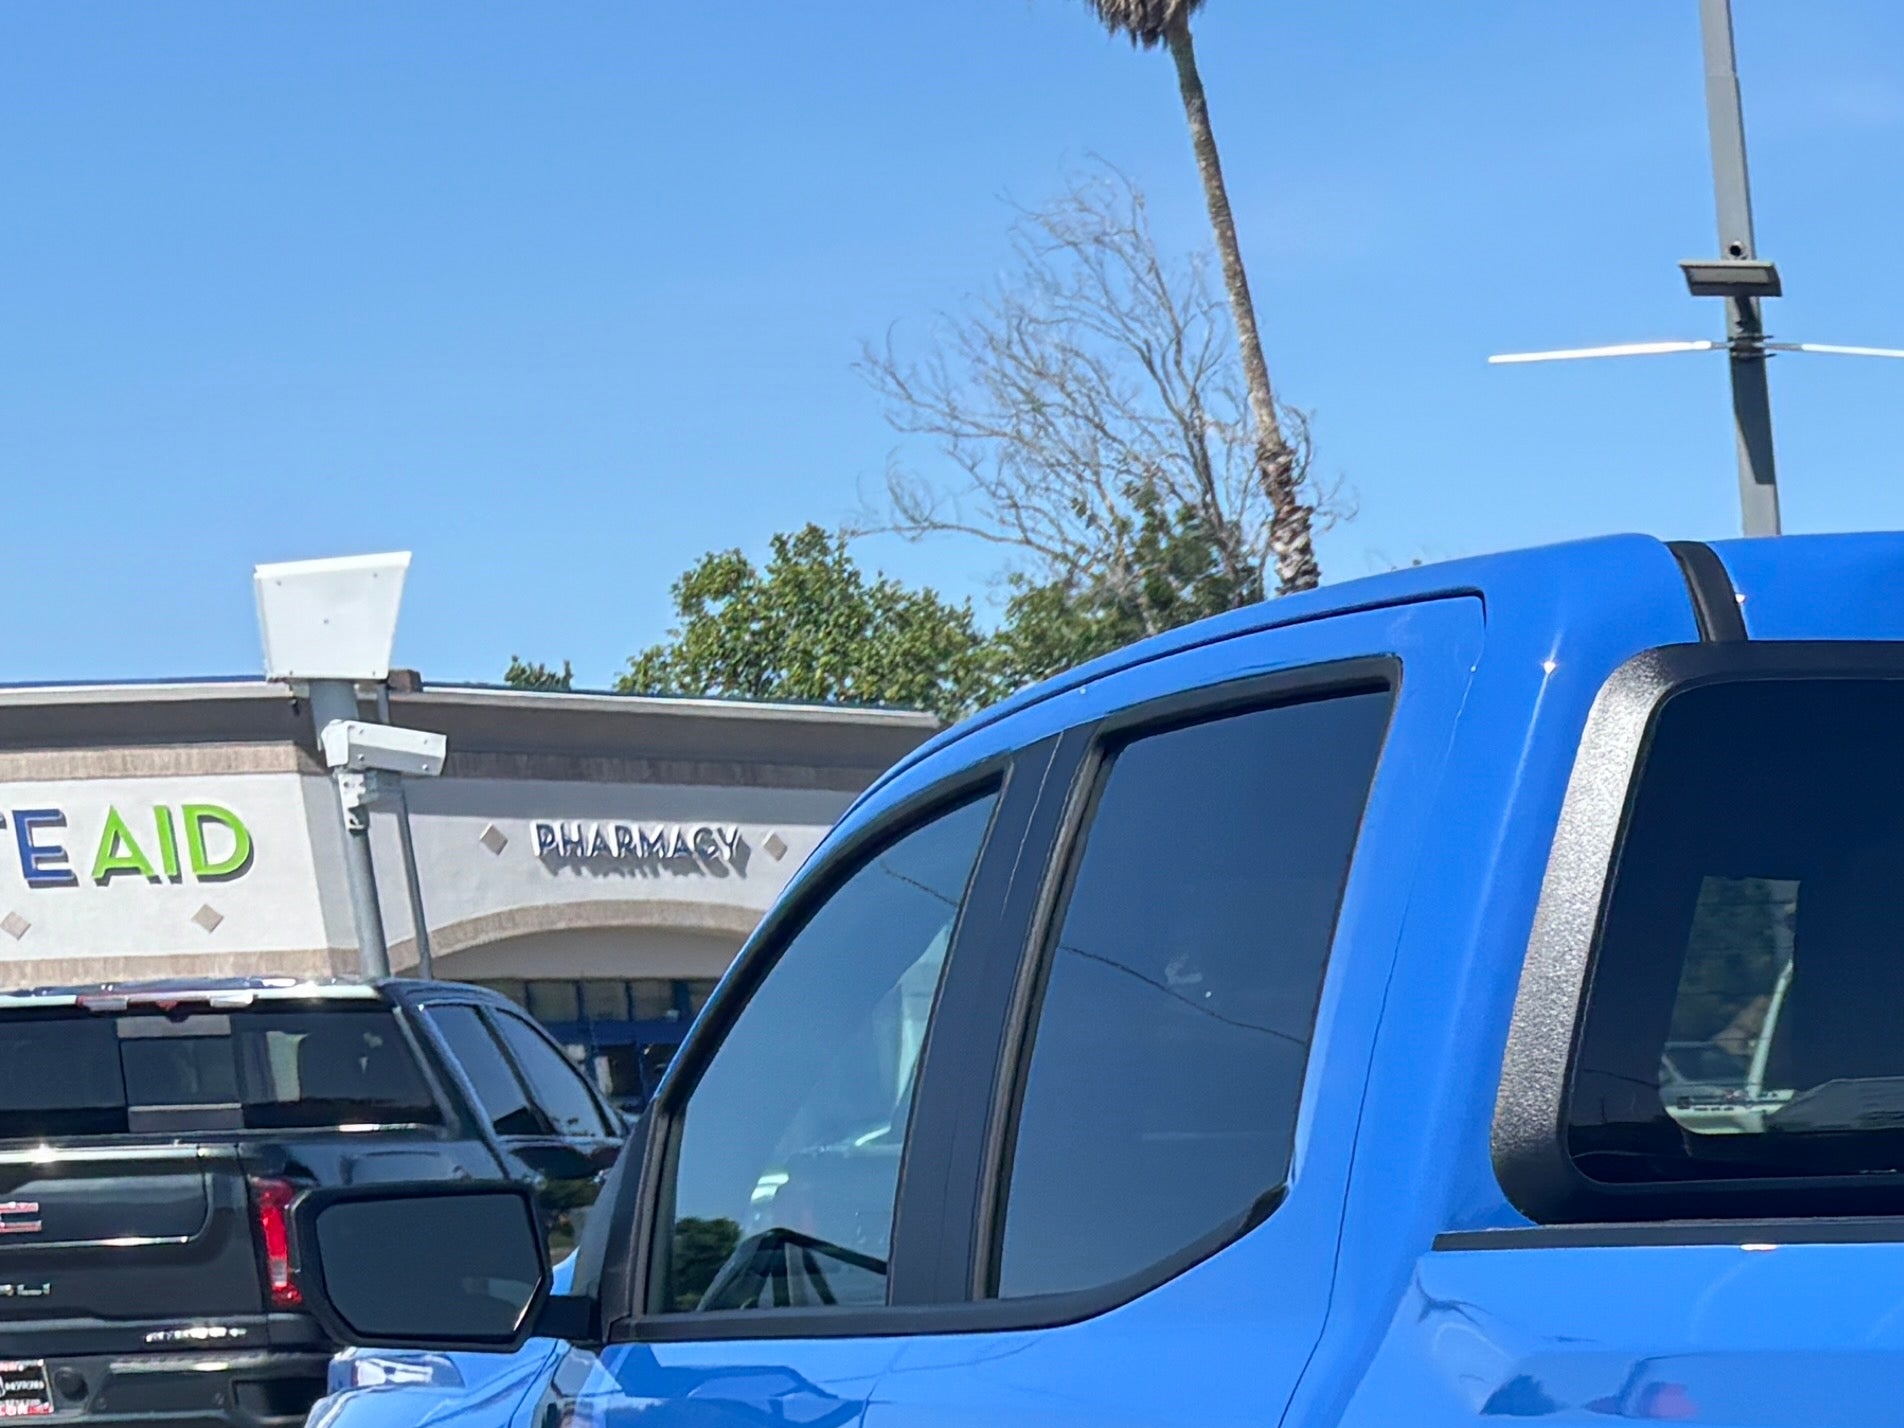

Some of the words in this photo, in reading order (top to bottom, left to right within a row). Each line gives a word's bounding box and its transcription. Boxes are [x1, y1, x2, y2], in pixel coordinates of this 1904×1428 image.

[0, 808, 79, 888] E
[91, 803, 254, 887] AID
[529, 819, 742, 862] PHARMACY
